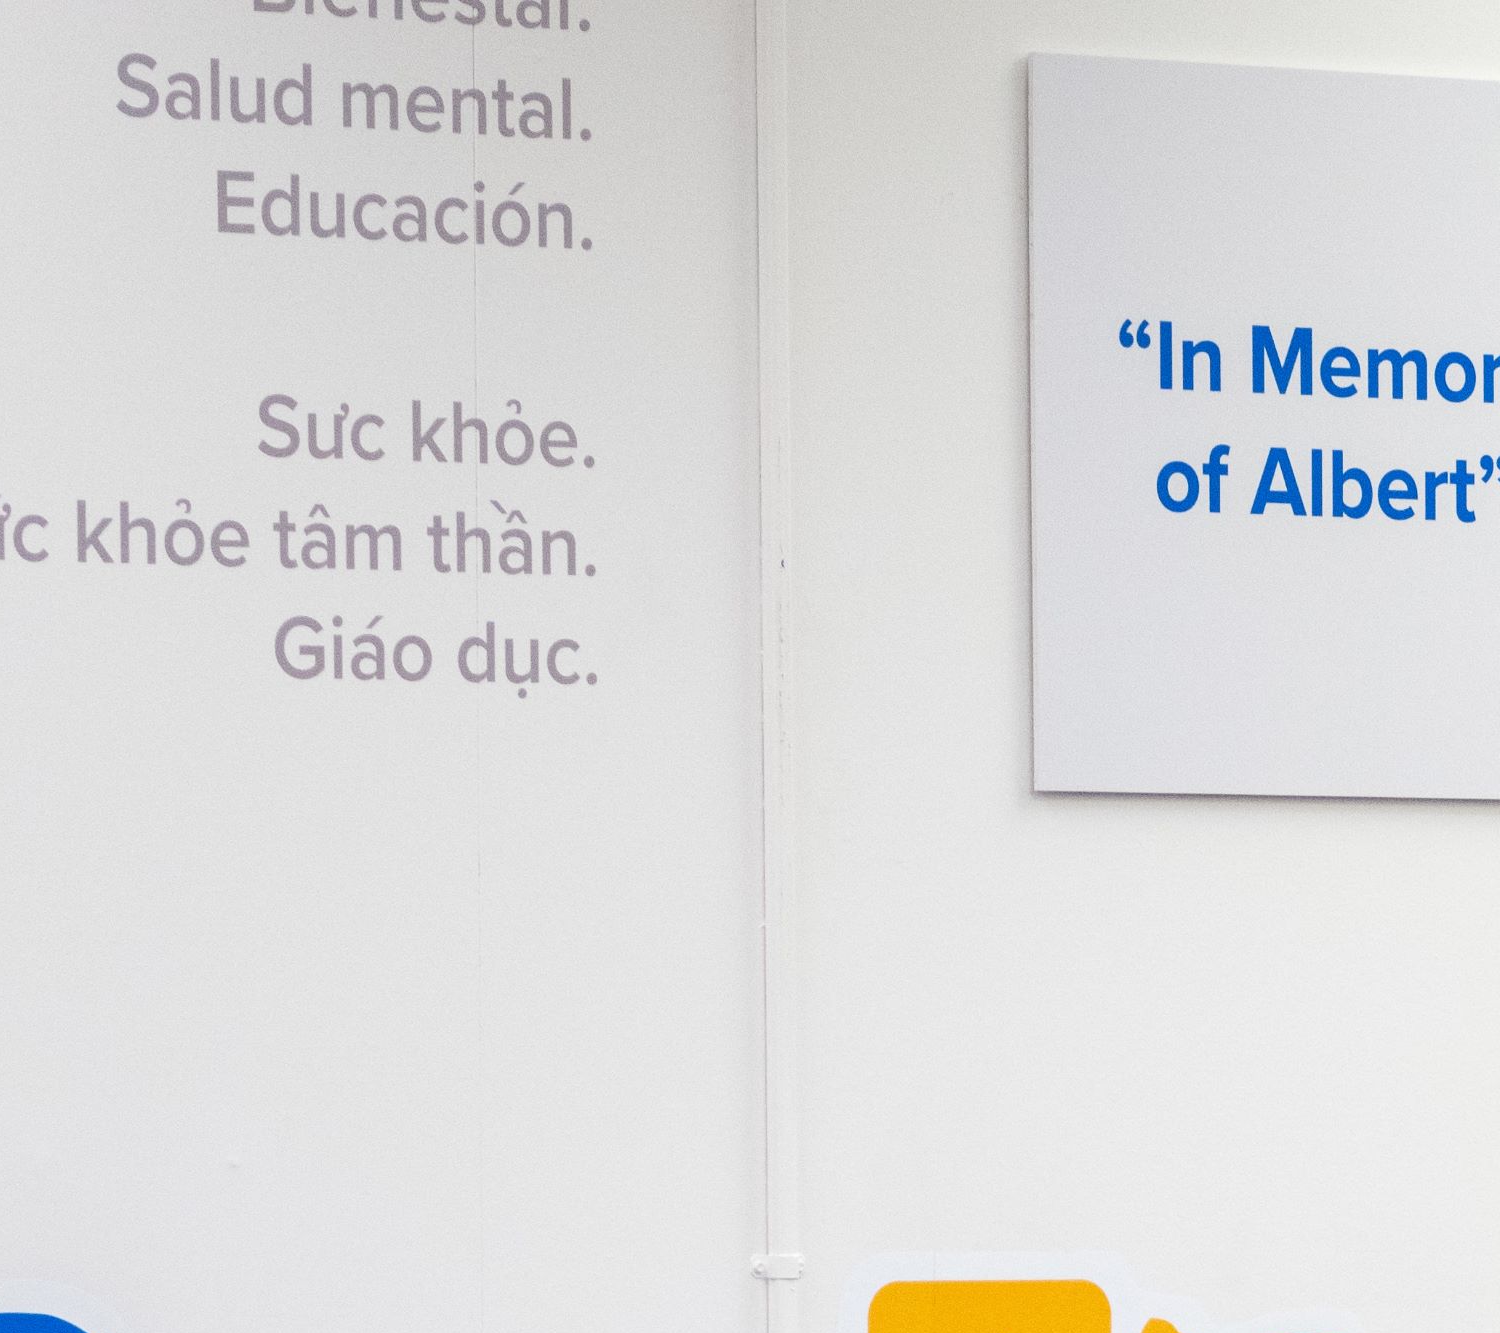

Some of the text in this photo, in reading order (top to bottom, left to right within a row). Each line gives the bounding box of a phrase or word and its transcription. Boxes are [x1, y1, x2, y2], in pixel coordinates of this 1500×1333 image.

[116, 52, 592, 142] Salud mental.
[216, 170, 593, 251] Educación.
[411, 399, 595, 469] khỏe.
[1155, 443, 1231, 514] of
[76, 498, 250, 568] khỏe
[272, 503, 402, 571] tâm
[426, 500, 597, 577] thần.
[274, 615, 598, 699] Giáo dục.
